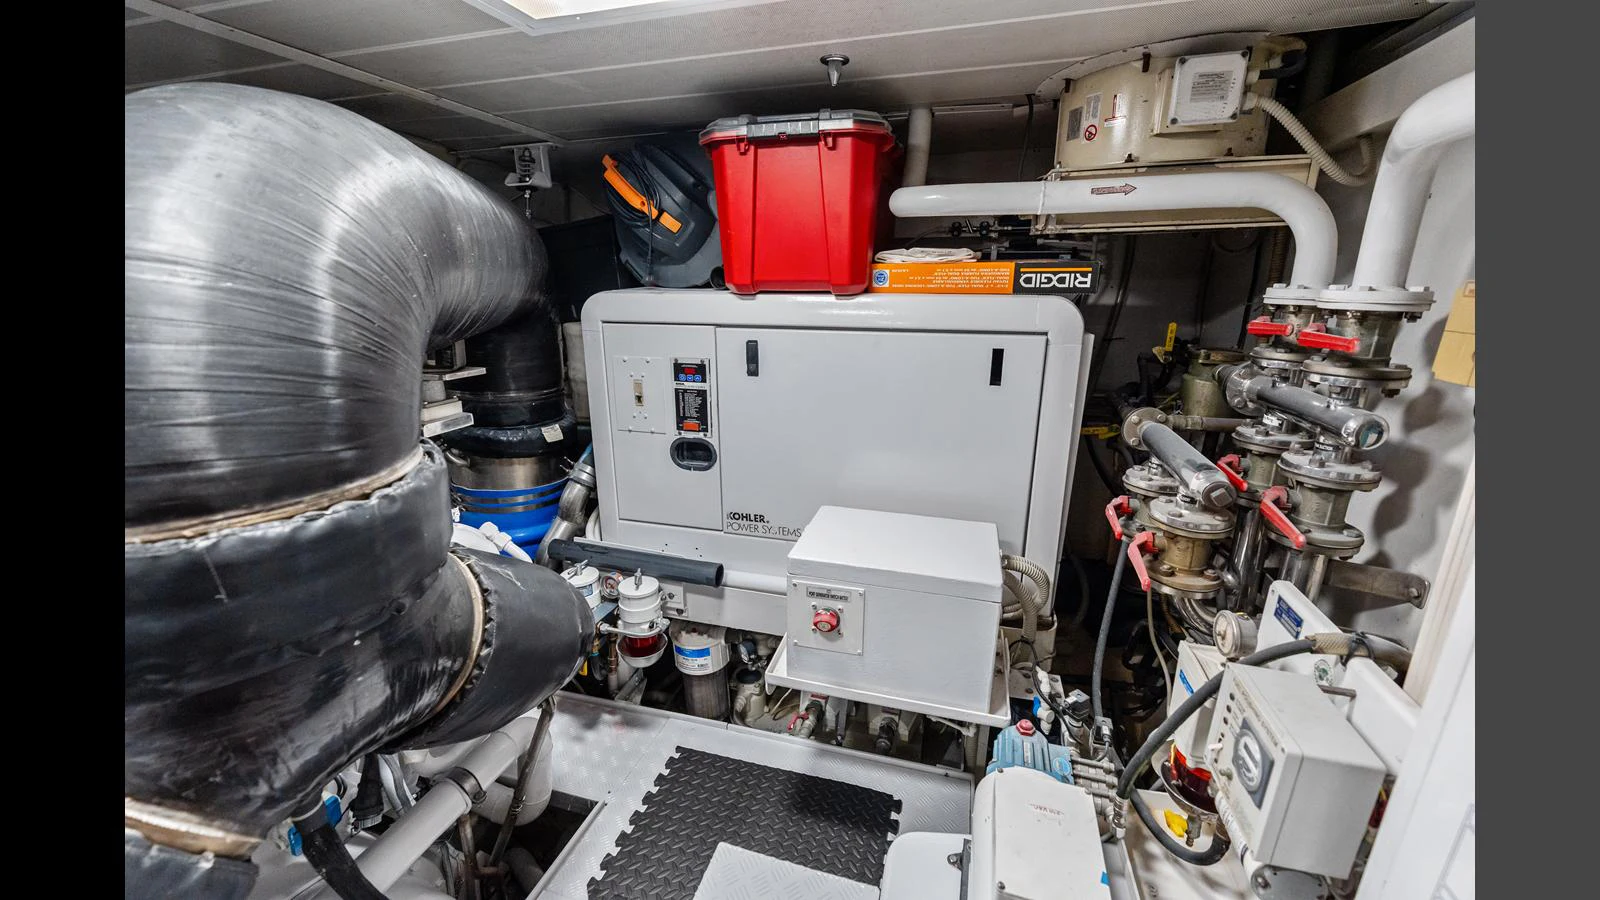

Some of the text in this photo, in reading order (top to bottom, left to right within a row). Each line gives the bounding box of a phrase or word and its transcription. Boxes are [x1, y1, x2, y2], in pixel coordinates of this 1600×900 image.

[1020, 273, 1092, 288] RIDGID
[727, 522, 802, 537] POWER SYTEMS
